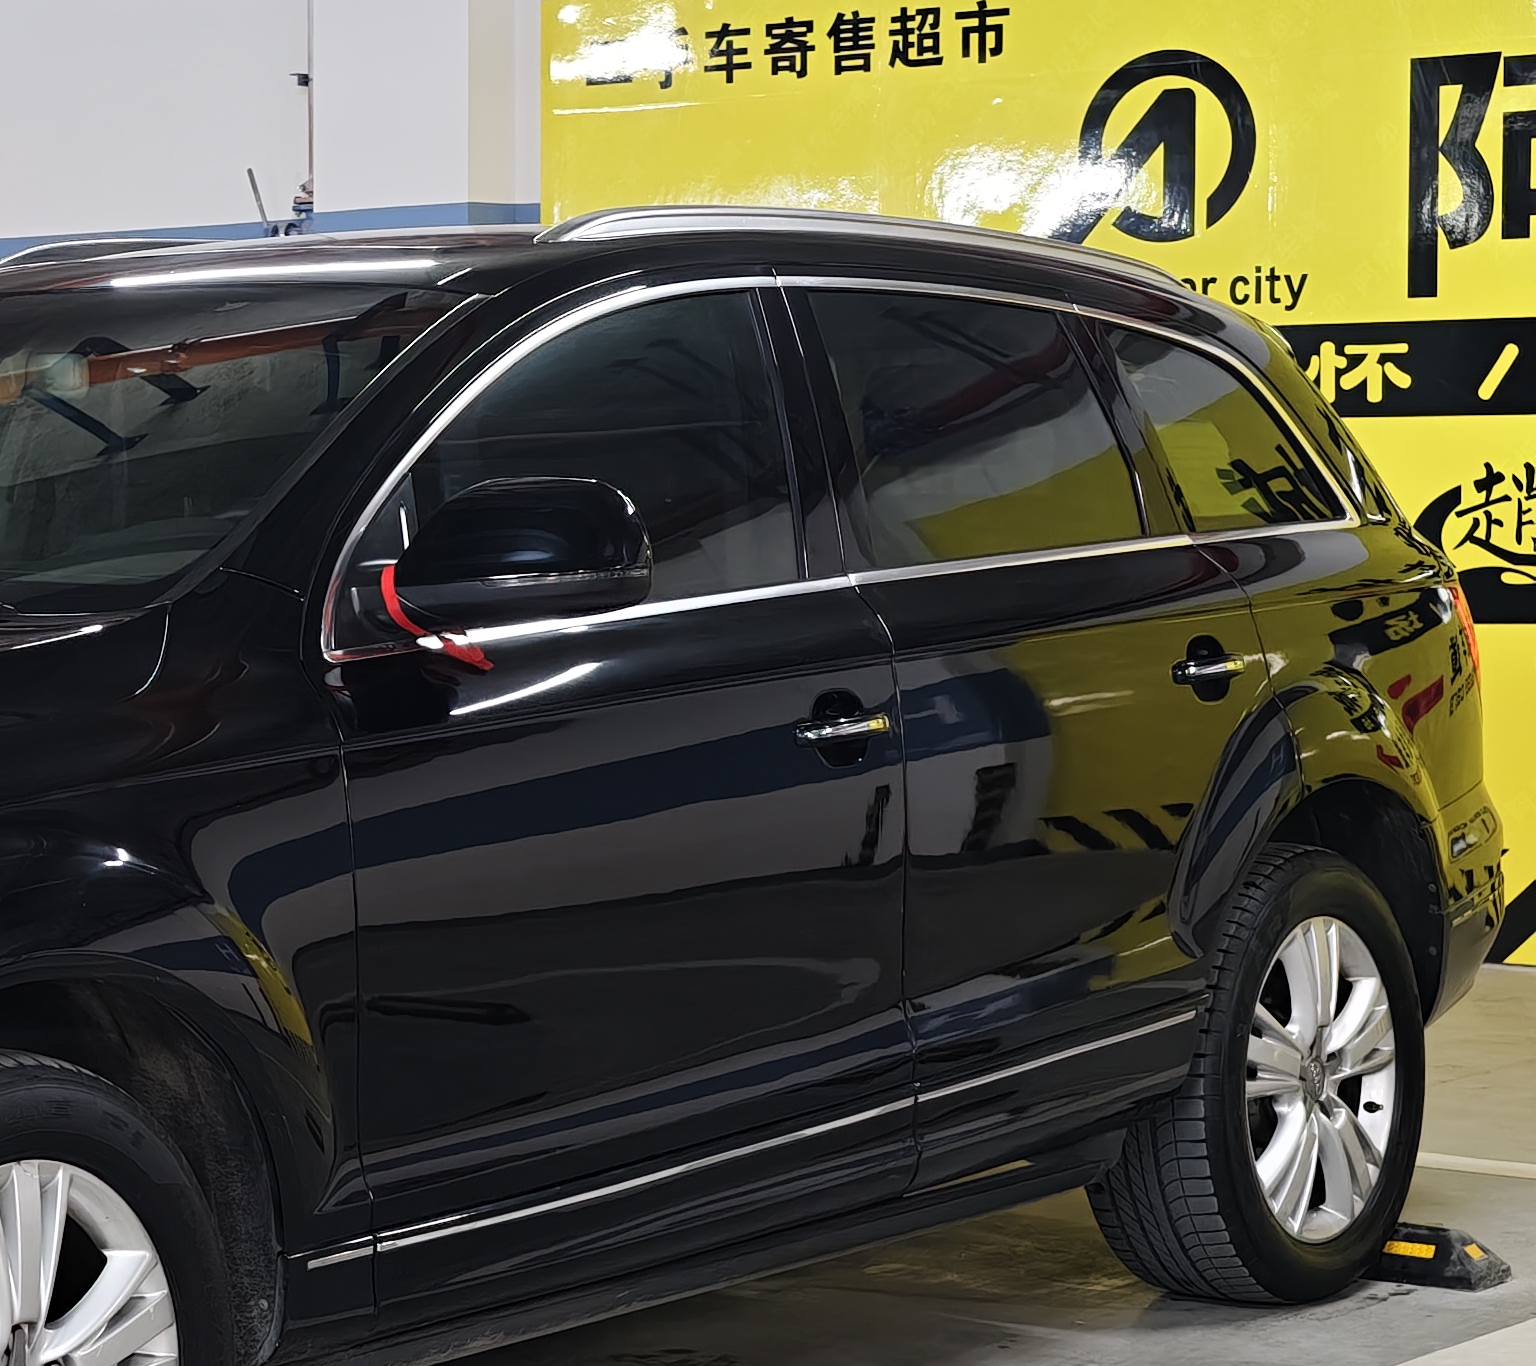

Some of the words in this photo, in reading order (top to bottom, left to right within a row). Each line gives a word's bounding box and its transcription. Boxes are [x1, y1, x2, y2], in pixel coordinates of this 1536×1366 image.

[585, 0, 1011, 90] 二车寄售超市
[1229, 265, 1309, 312] city
